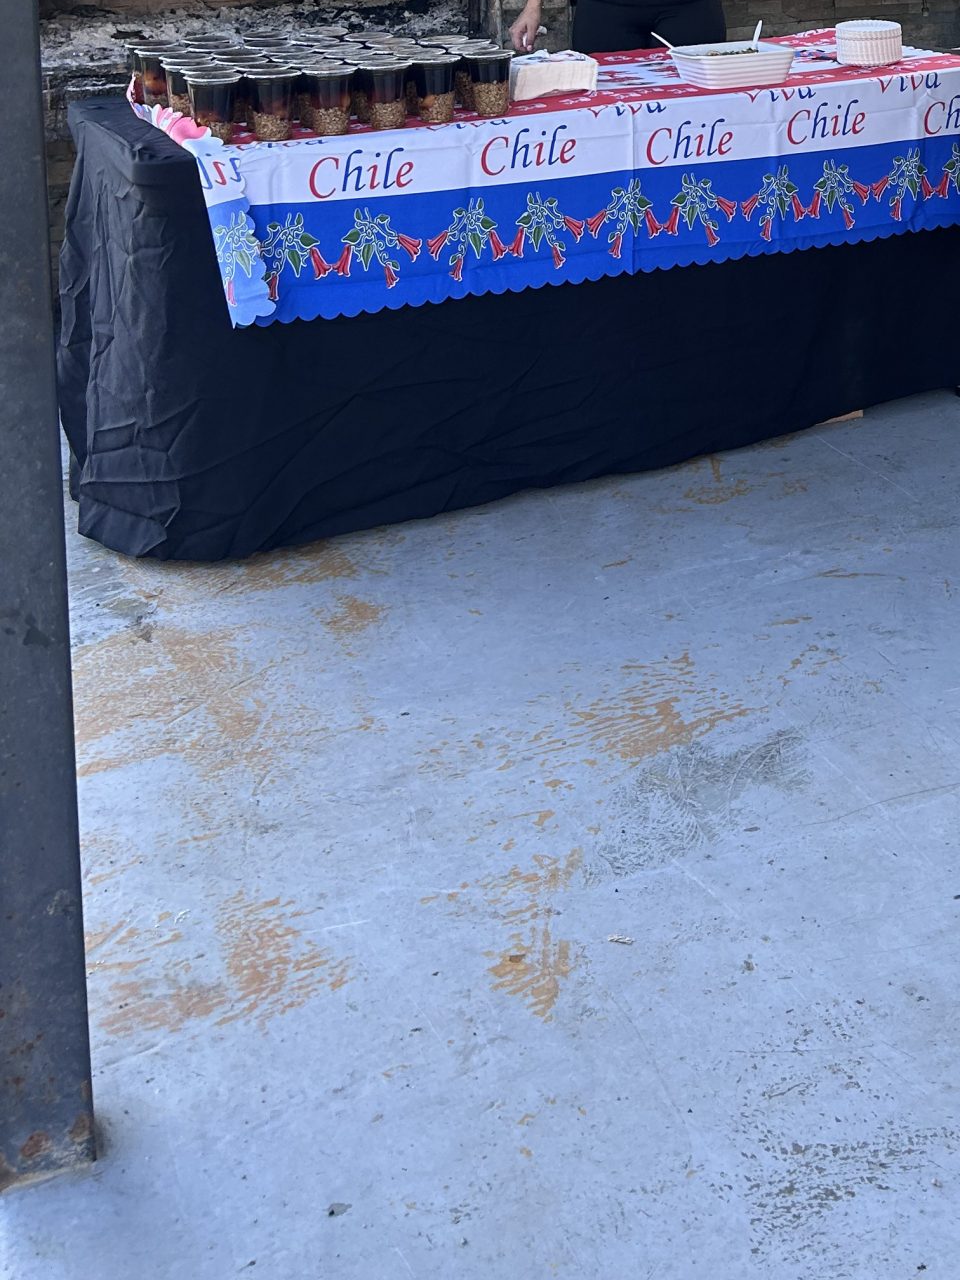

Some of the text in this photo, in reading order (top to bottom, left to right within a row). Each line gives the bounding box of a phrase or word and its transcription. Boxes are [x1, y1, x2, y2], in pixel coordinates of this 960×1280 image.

[646, 118, 734, 166] Chile
[786, 99, 866, 145] Chile
[308, 147, 415, 200] Chile
[480, 124, 577, 176] Chile
